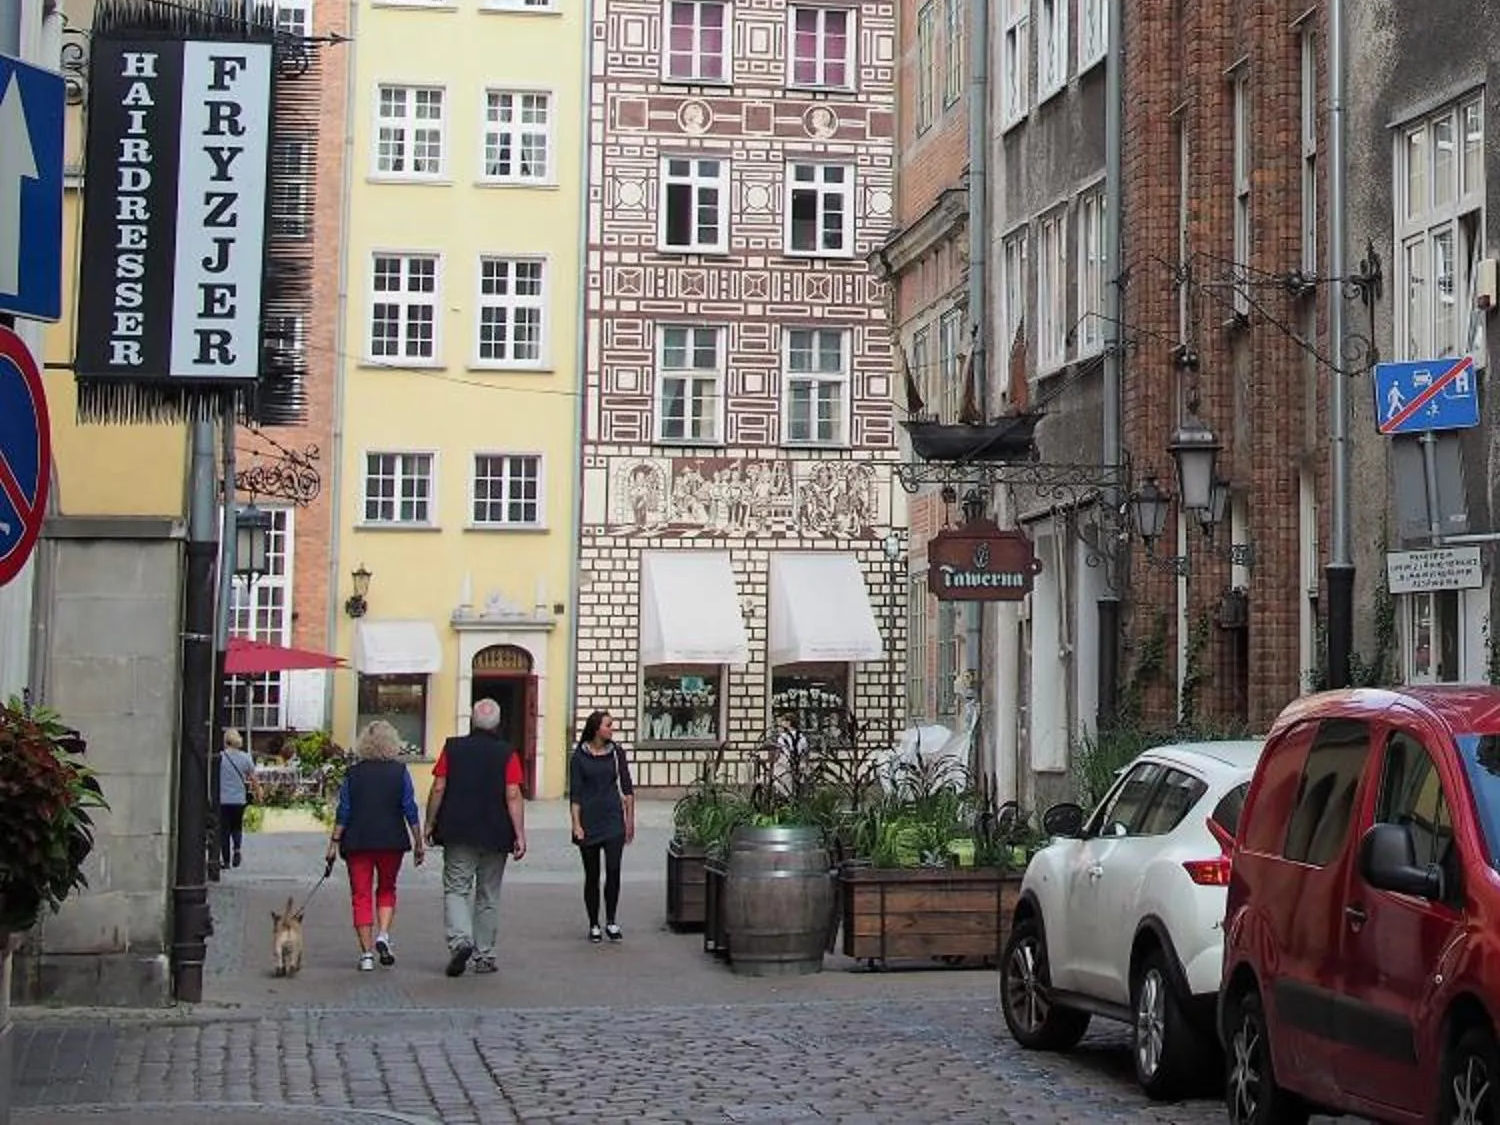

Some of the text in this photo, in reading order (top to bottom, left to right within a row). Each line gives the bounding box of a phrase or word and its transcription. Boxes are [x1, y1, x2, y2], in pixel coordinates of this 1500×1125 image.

[109, 52, 159, 366] HAIRDRESSER
[192, 55, 247, 366] FRYZJER
[940, 565, 1023, 587] Tawerna
